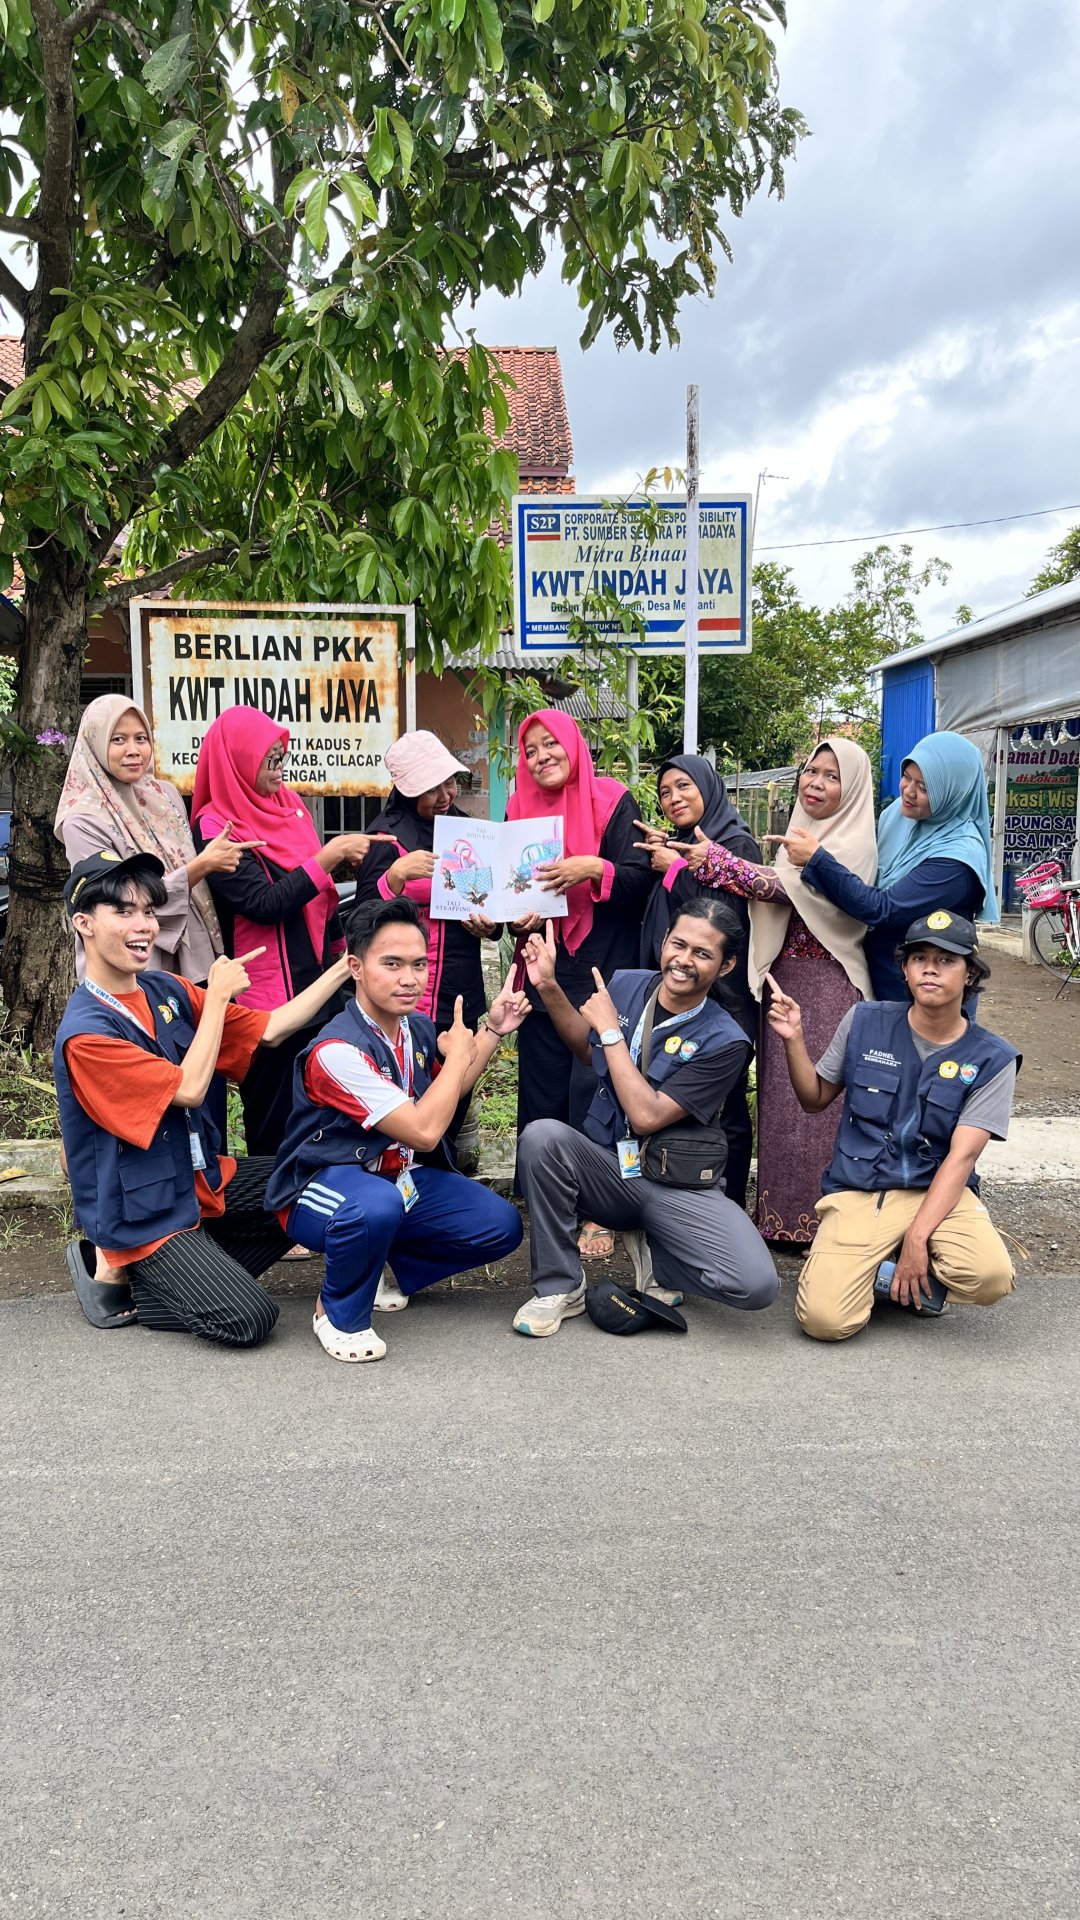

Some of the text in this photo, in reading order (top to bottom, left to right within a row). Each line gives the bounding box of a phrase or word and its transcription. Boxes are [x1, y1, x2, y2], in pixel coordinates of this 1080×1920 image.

[530, 516, 556, 530] S2P
[564, 513, 619, 524] CORPORATE
[657, 511, 737, 523] RESPOSIBILITY
[565, 527, 580, 540] PT.
[583, 526, 627, 540] SUMBER
[575, 545, 624, 562] Mitra
[532, 570, 584, 597] KWT
[594, 569, 666, 596] INDAH
[648, 600, 670, 611] Desa
[673, 599, 716, 611] Meanti
[174, 633, 373, 662] BERLIAN PKK
[169, 676, 381, 723] KWT INDAH JAYA
[306, 738, 351, 750] KADUS
[355, 739, 362, 750] 7
[291, 755, 322, 766] KAB.
[326, 754, 382, 766] CILACAP
[282, 770, 327, 782] ENGAH
